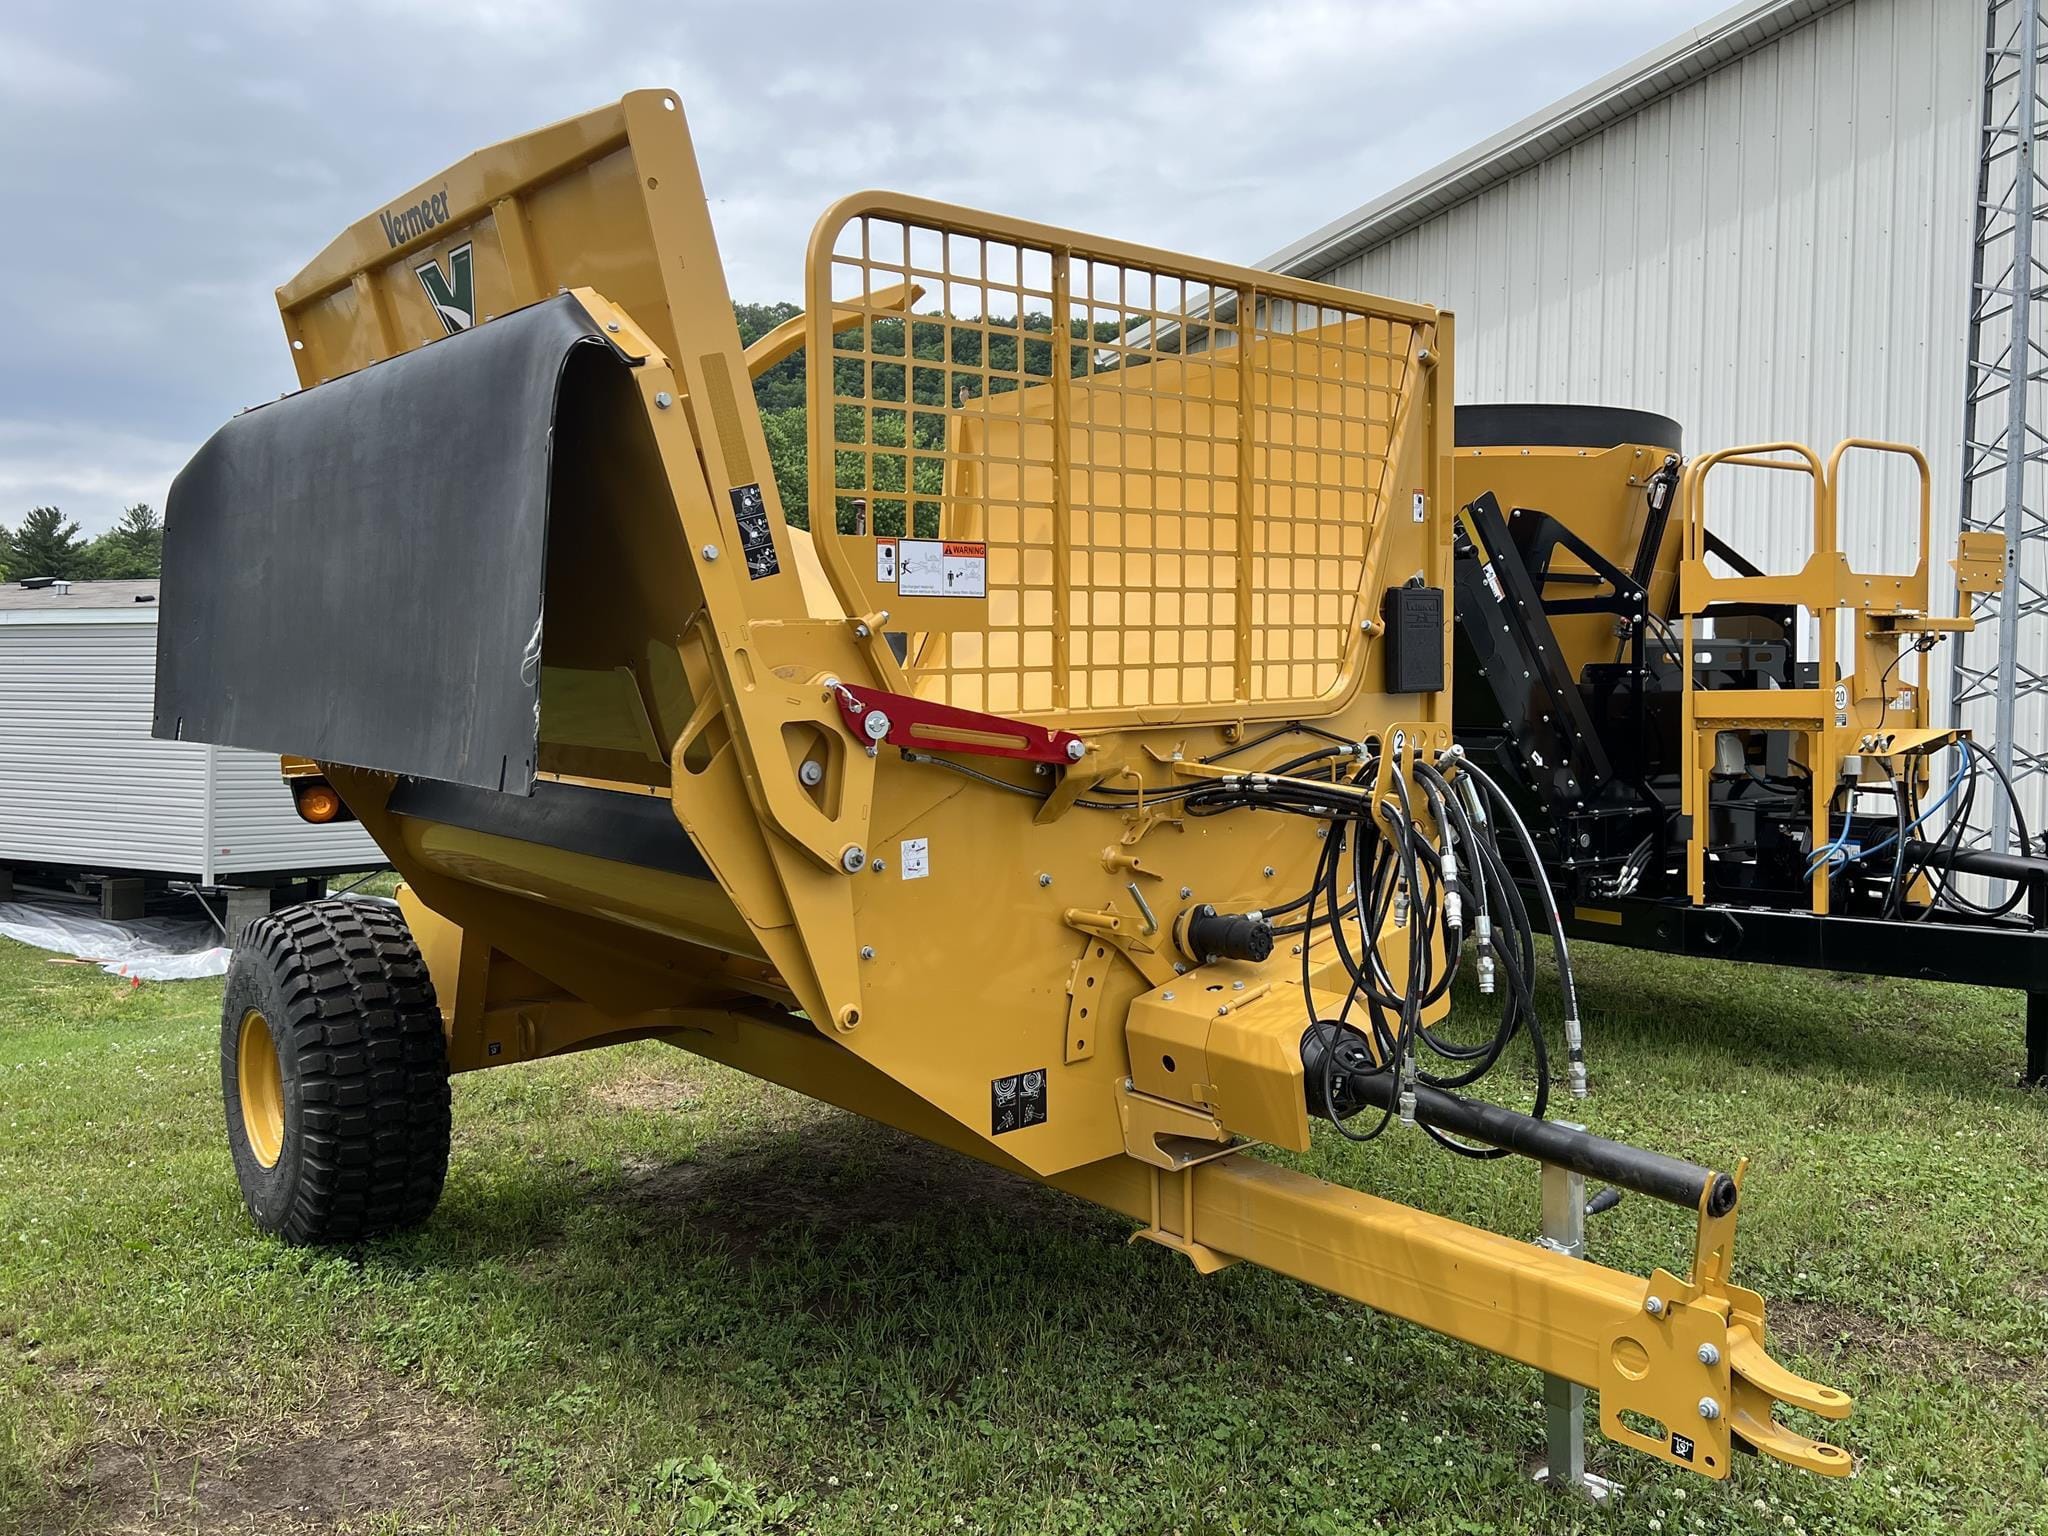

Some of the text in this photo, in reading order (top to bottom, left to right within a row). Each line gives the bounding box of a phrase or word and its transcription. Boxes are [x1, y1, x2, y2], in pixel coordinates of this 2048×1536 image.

[379, 191, 450, 248] Vermeer
[953, 545, 984, 555] WARNING
[1835, 690, 1845, 702] 20
